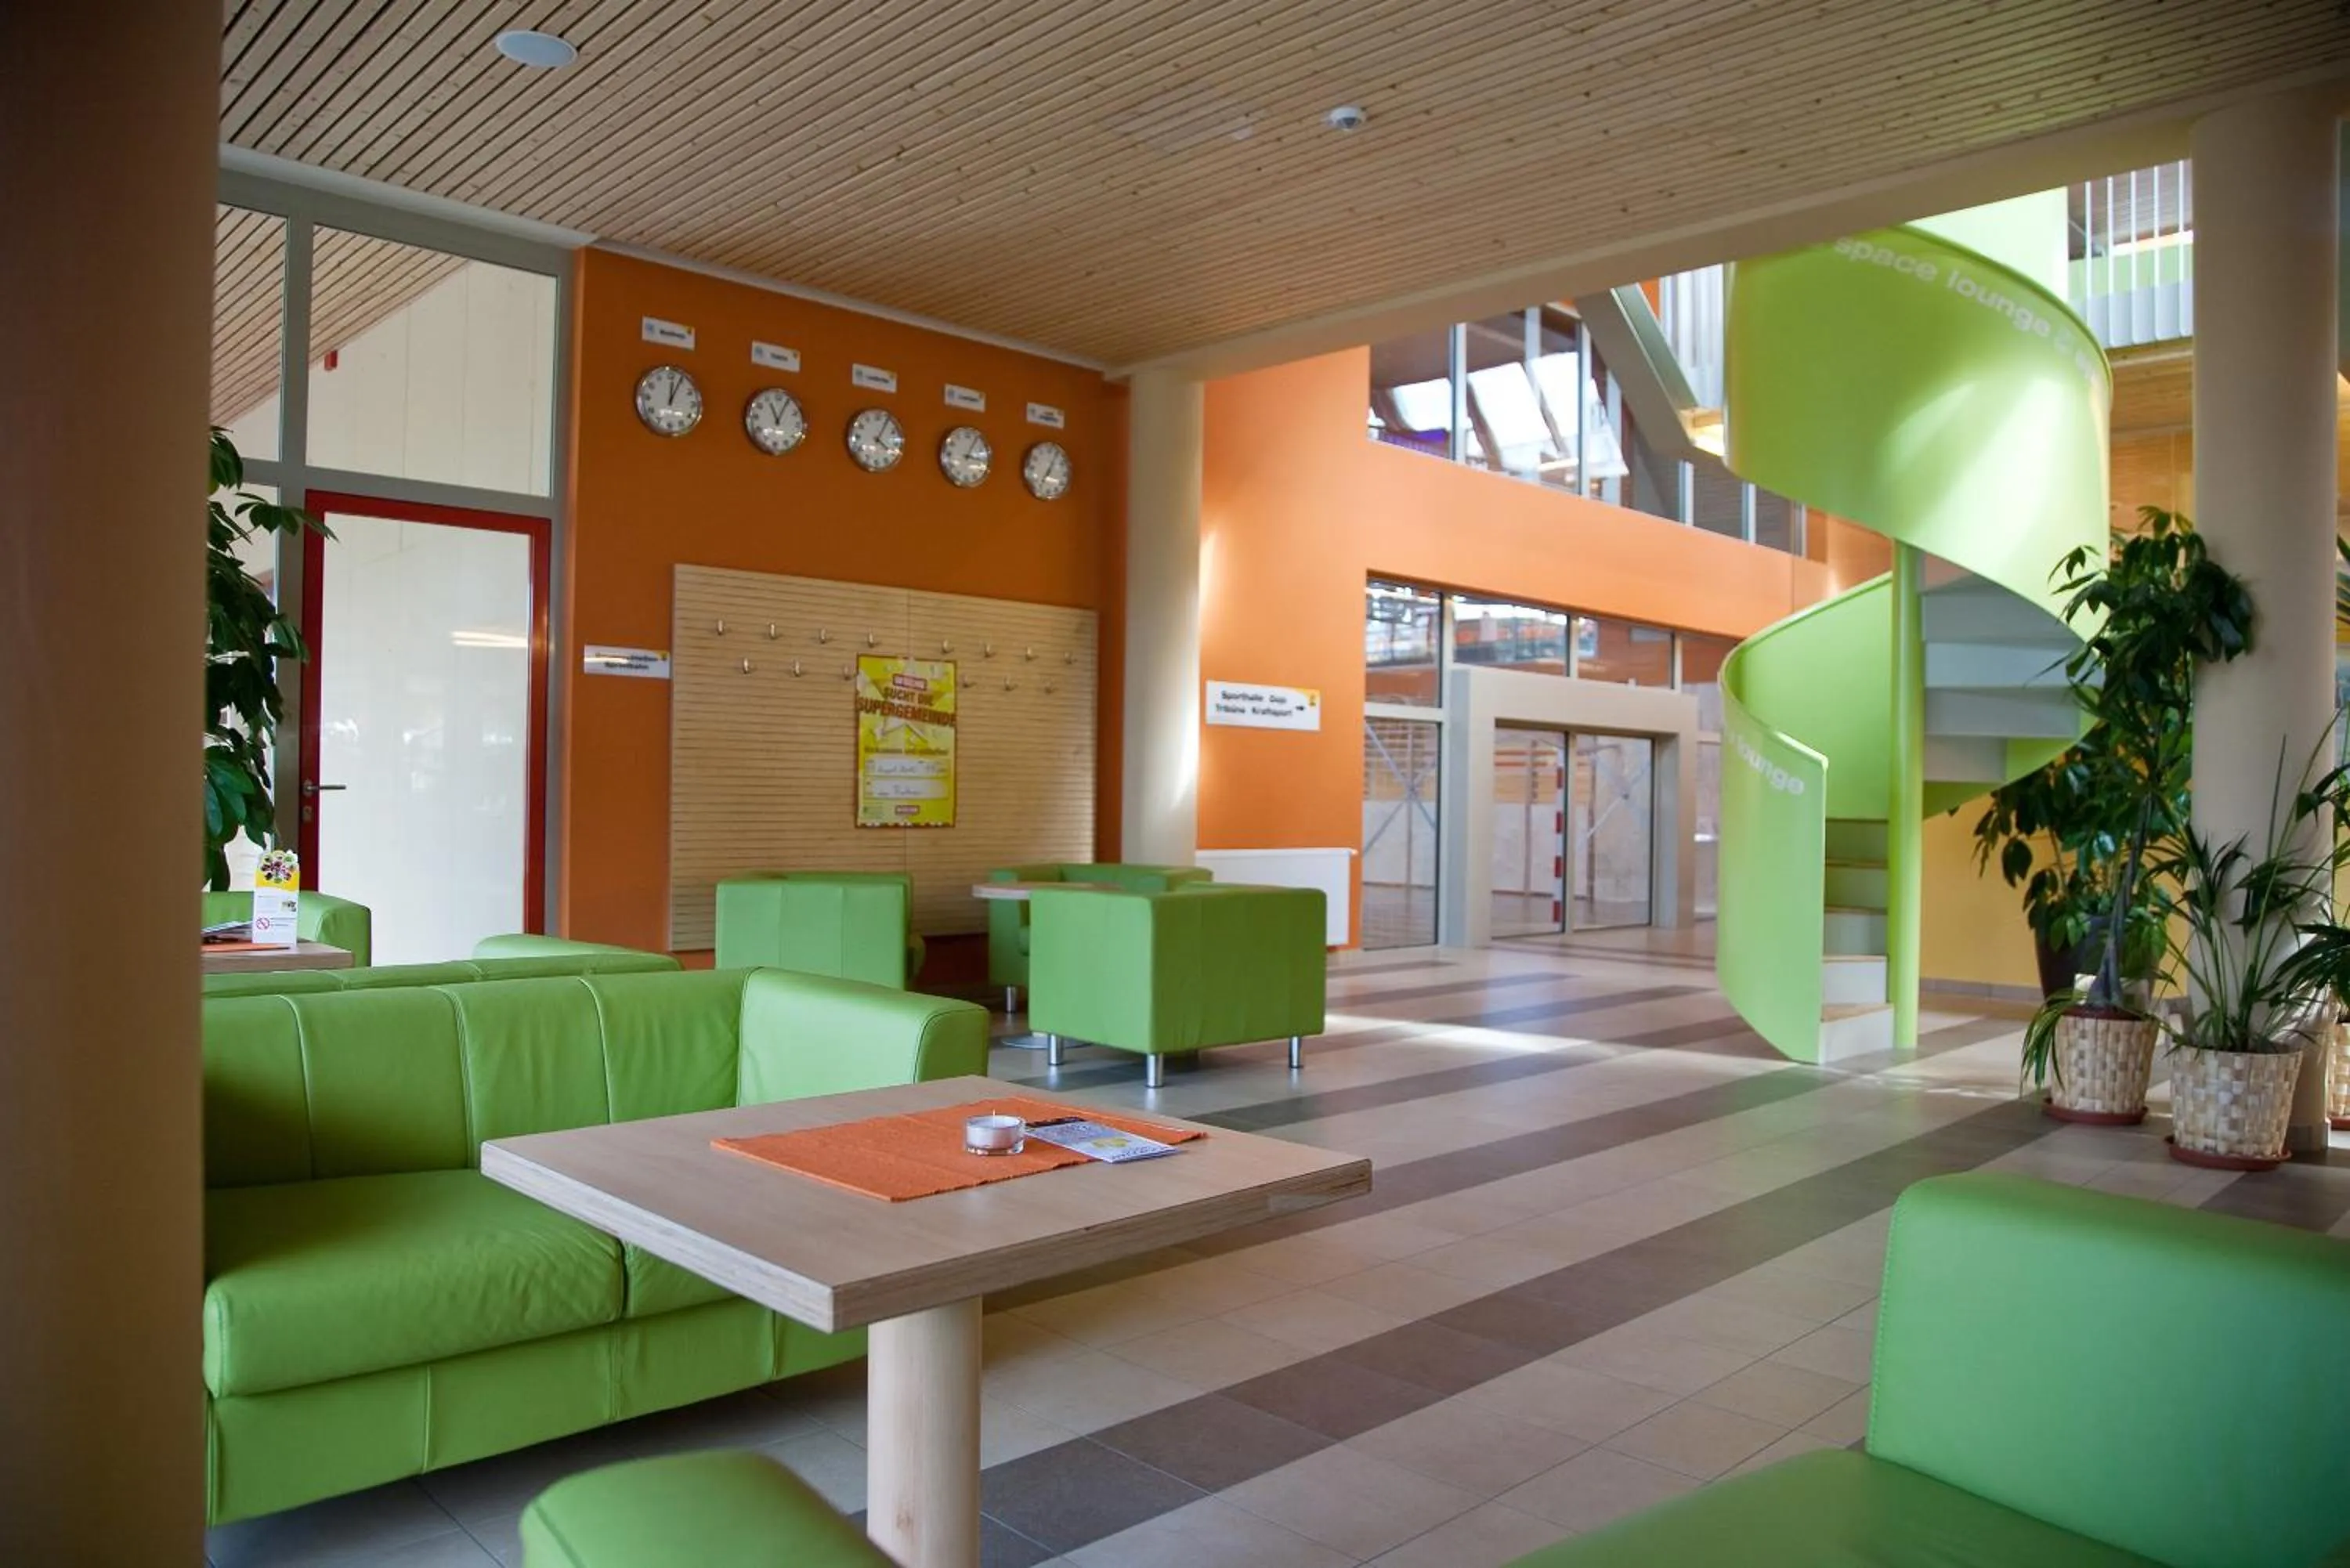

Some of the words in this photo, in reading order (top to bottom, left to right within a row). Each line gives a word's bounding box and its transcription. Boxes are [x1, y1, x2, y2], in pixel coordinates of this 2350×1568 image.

[1835, 237, 1938, 283] space
[1946, 269, 2052, 338] lounge
[884, 687, 916, 703] SUCHT
[1221, 690, 1264, 702] Sporthalle
[857, 698, 956, 726] SUPERGEMEINDE
[1215, 703, 1246, 714] Tribüne
[1251, 706, 1293, 717] Kraftsport
